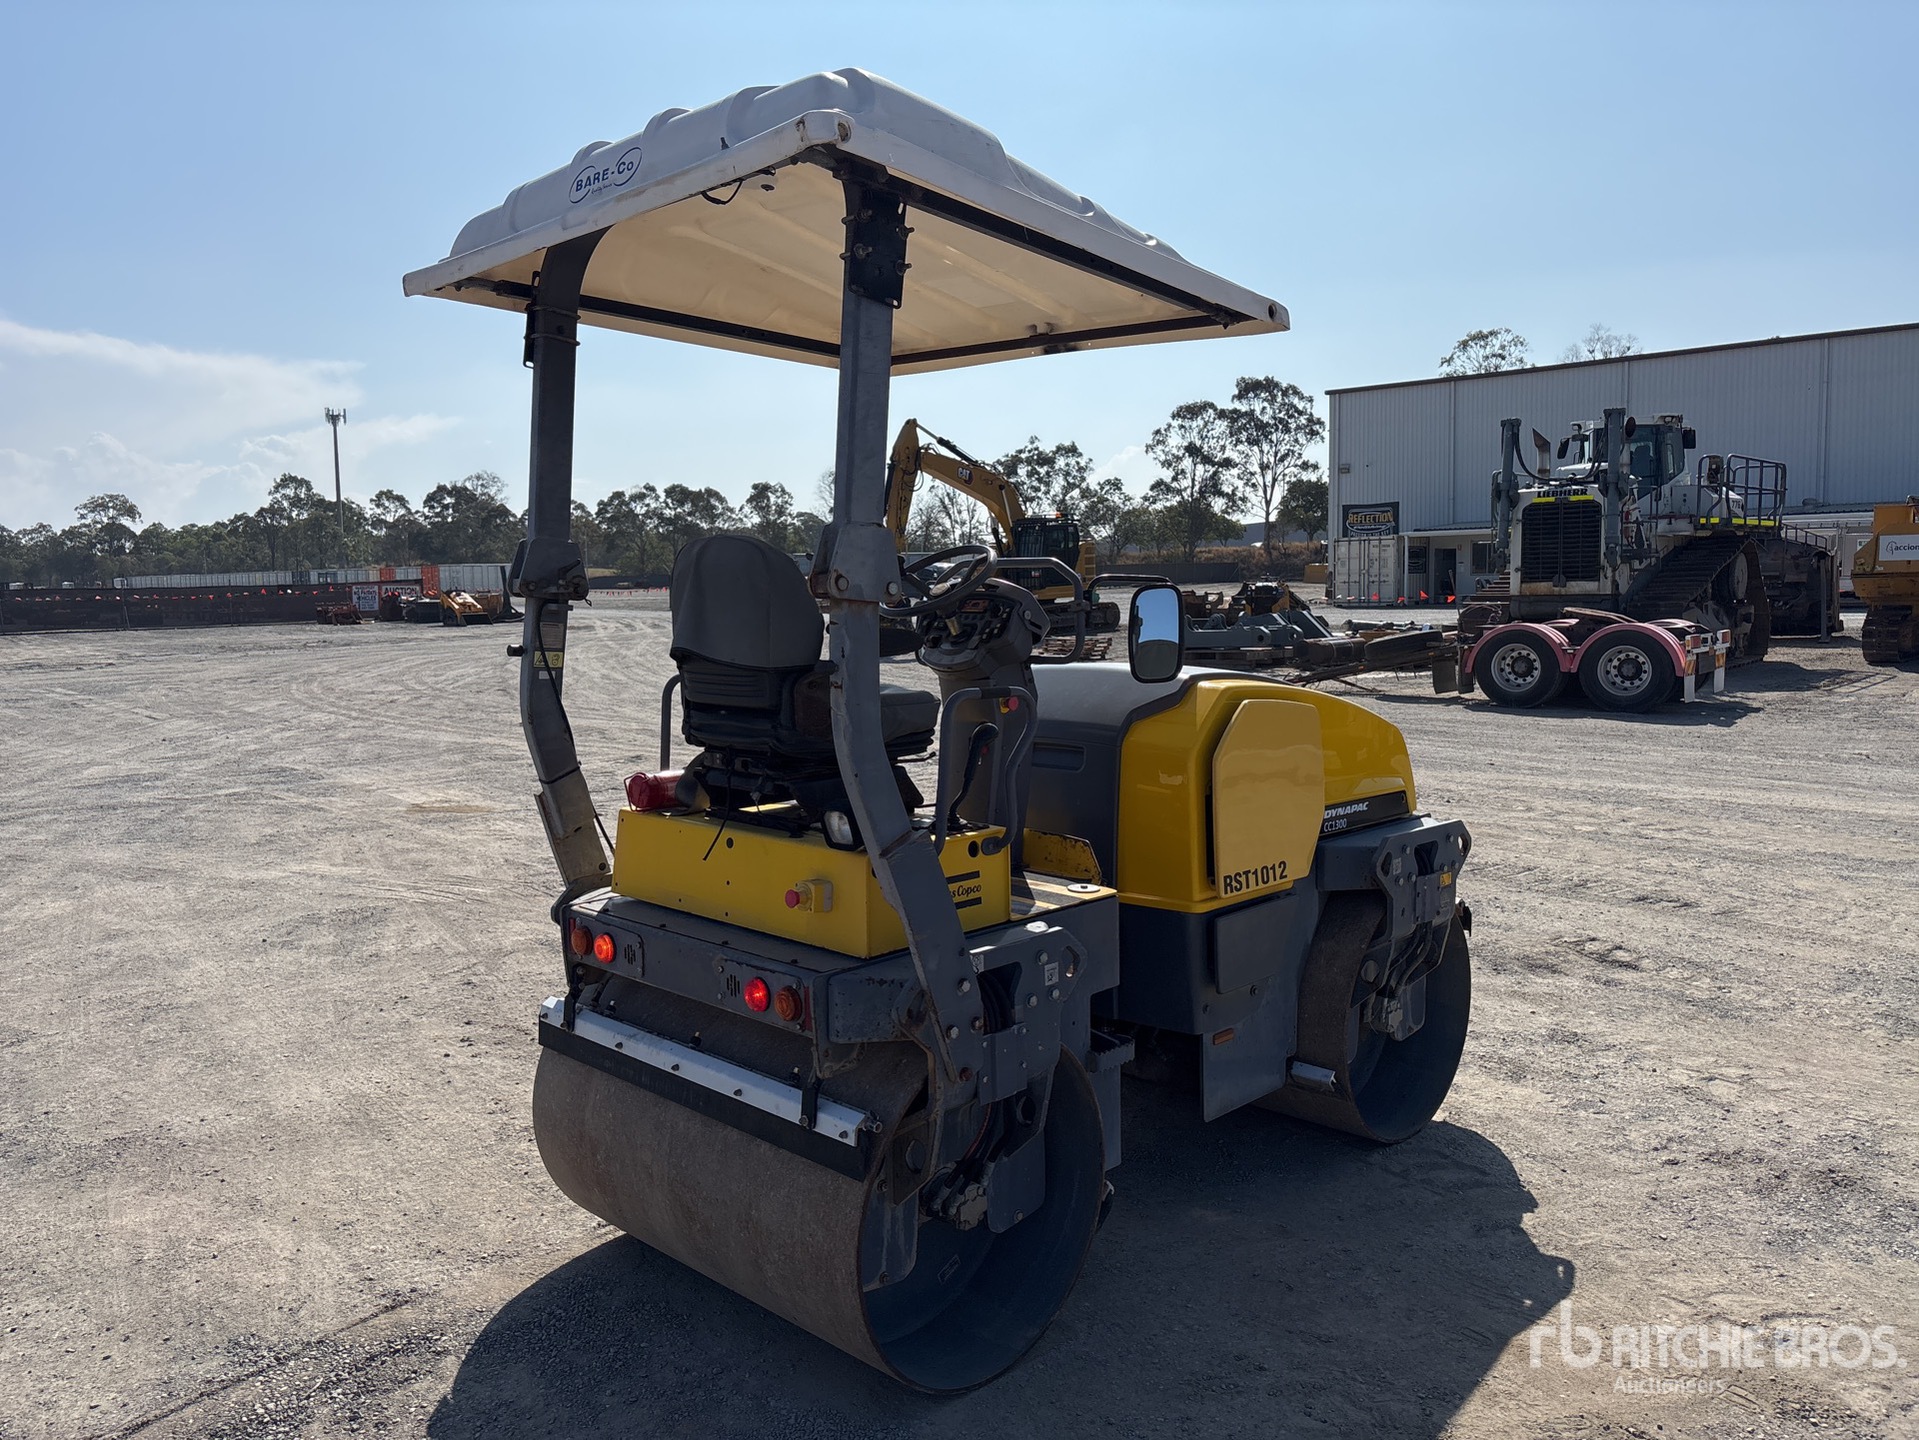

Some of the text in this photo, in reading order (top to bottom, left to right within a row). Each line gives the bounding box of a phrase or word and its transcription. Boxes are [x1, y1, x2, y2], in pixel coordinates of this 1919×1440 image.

[575, 161, 634, 192] BARE-Co
[958, 467, 971, 480] CAT
[1536, 488, 1588, 498] LIEBHERR
[1348, 511, 1393, 524] REFLECTION
[384, 586, 417, 597] AUCTION
[1324, 801, 1369, 819] DYNAPAC
[1323, 818, 1347, 832] CC1300
[1223, 860, 1288, 895] RST1012
[957, 884, 982, 898] Copco
